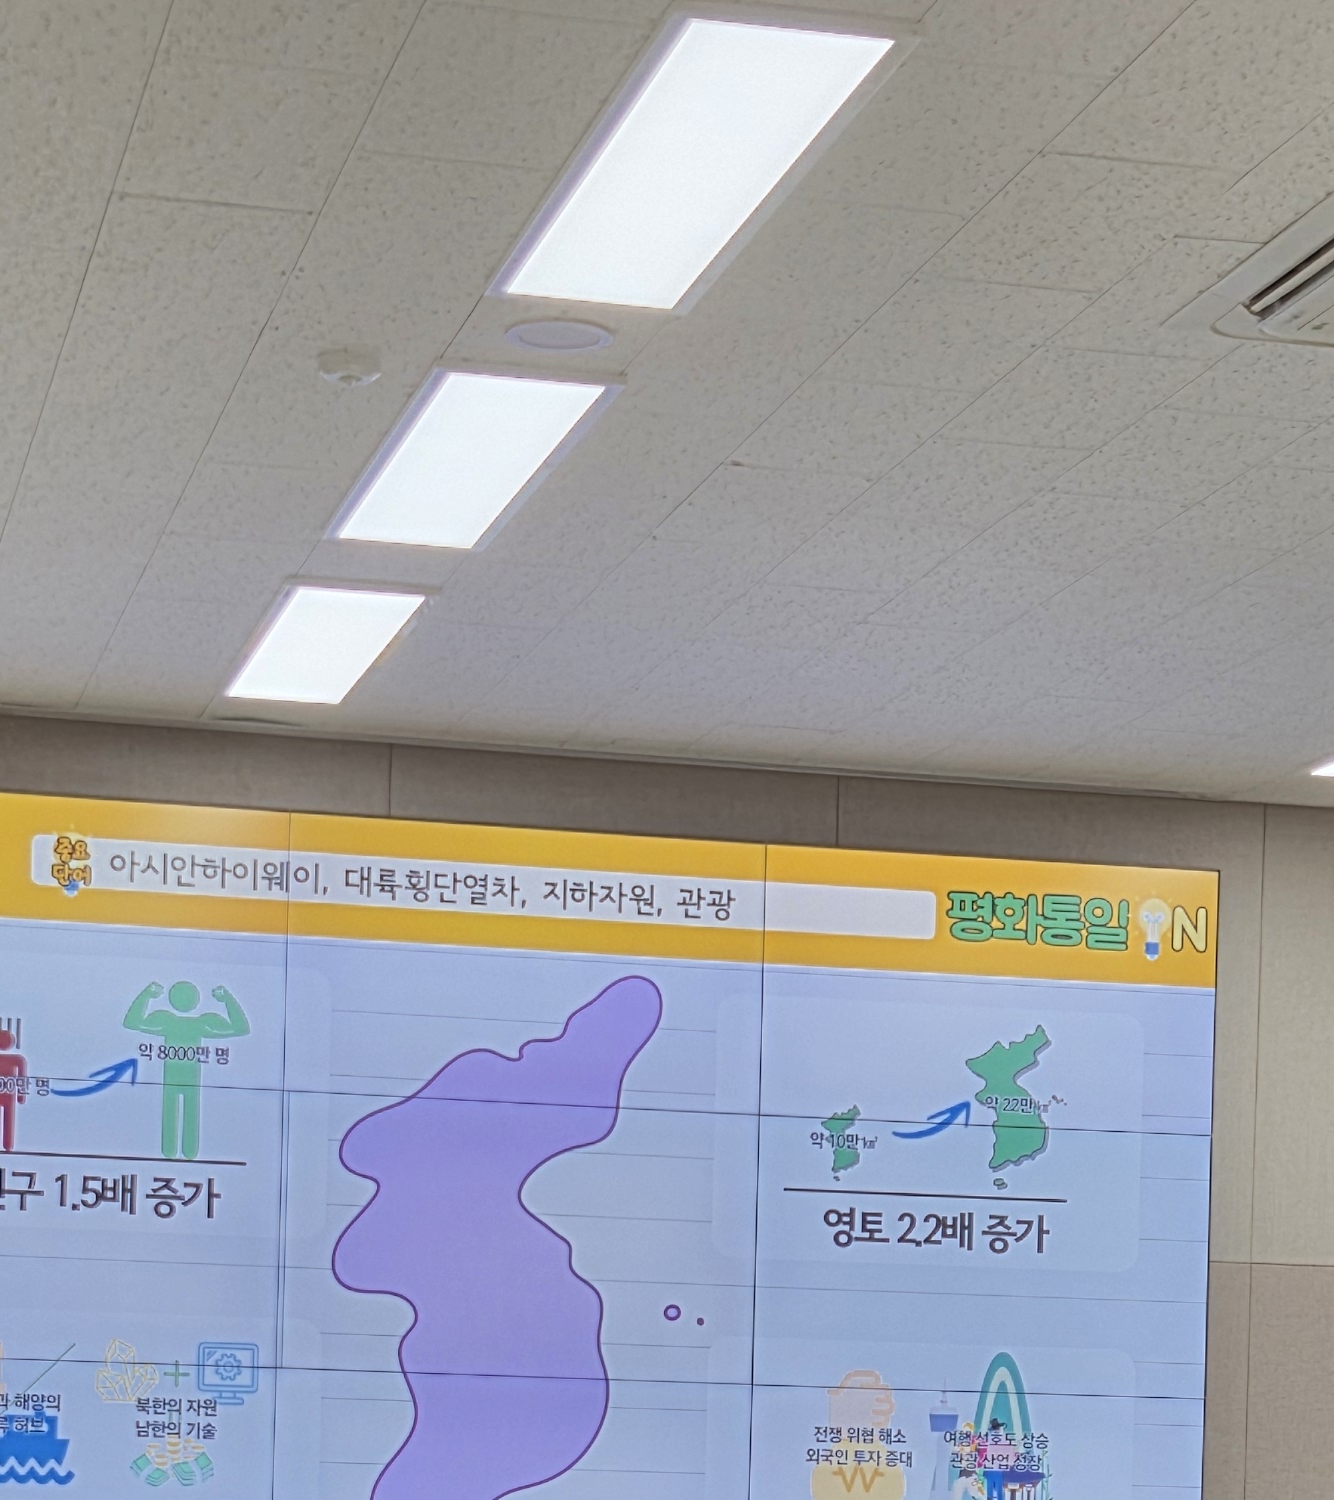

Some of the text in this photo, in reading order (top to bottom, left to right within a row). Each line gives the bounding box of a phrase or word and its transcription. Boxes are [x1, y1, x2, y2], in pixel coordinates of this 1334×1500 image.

[54, 836, 90, 864] 중요
[52, 863, 92, 887] 단어
[109, 850, 736, 922] 아시안하이웨이, 대륙횡단열차, 지하자원, 관광
[946, 890, 1130, 952] 평화통일
[138, 1043, 230, 1065] 약 8000만 명
[35, 1077, 50, 1097] 명
[985, 1096, 999, 1112] 약
[810, 1132, 824, 1149] 약
[55, 1174, 137, 1215] 1.5배
[145, 1177, 222, 1219] 증가
[823, 1207, 1051, 1254] 영토 2.2배 증가
[14, 1393, 61, 1412] 해양의
[136, 1397, 218, 1417] 북한의 자원
[14, 1417, 46, 1433] 허브
[136, 1421, 218, 1440] 남한의 기술
[814, 1426, 907, 1445] 전쟁 위협 해소
[943, 1431, 1049, 1449] 여행 선호도 상승
[806, 1449, 913, 1468] 외국인 투자 증대
[950, 1452, 1043, 1471] 관광 산업 성장
